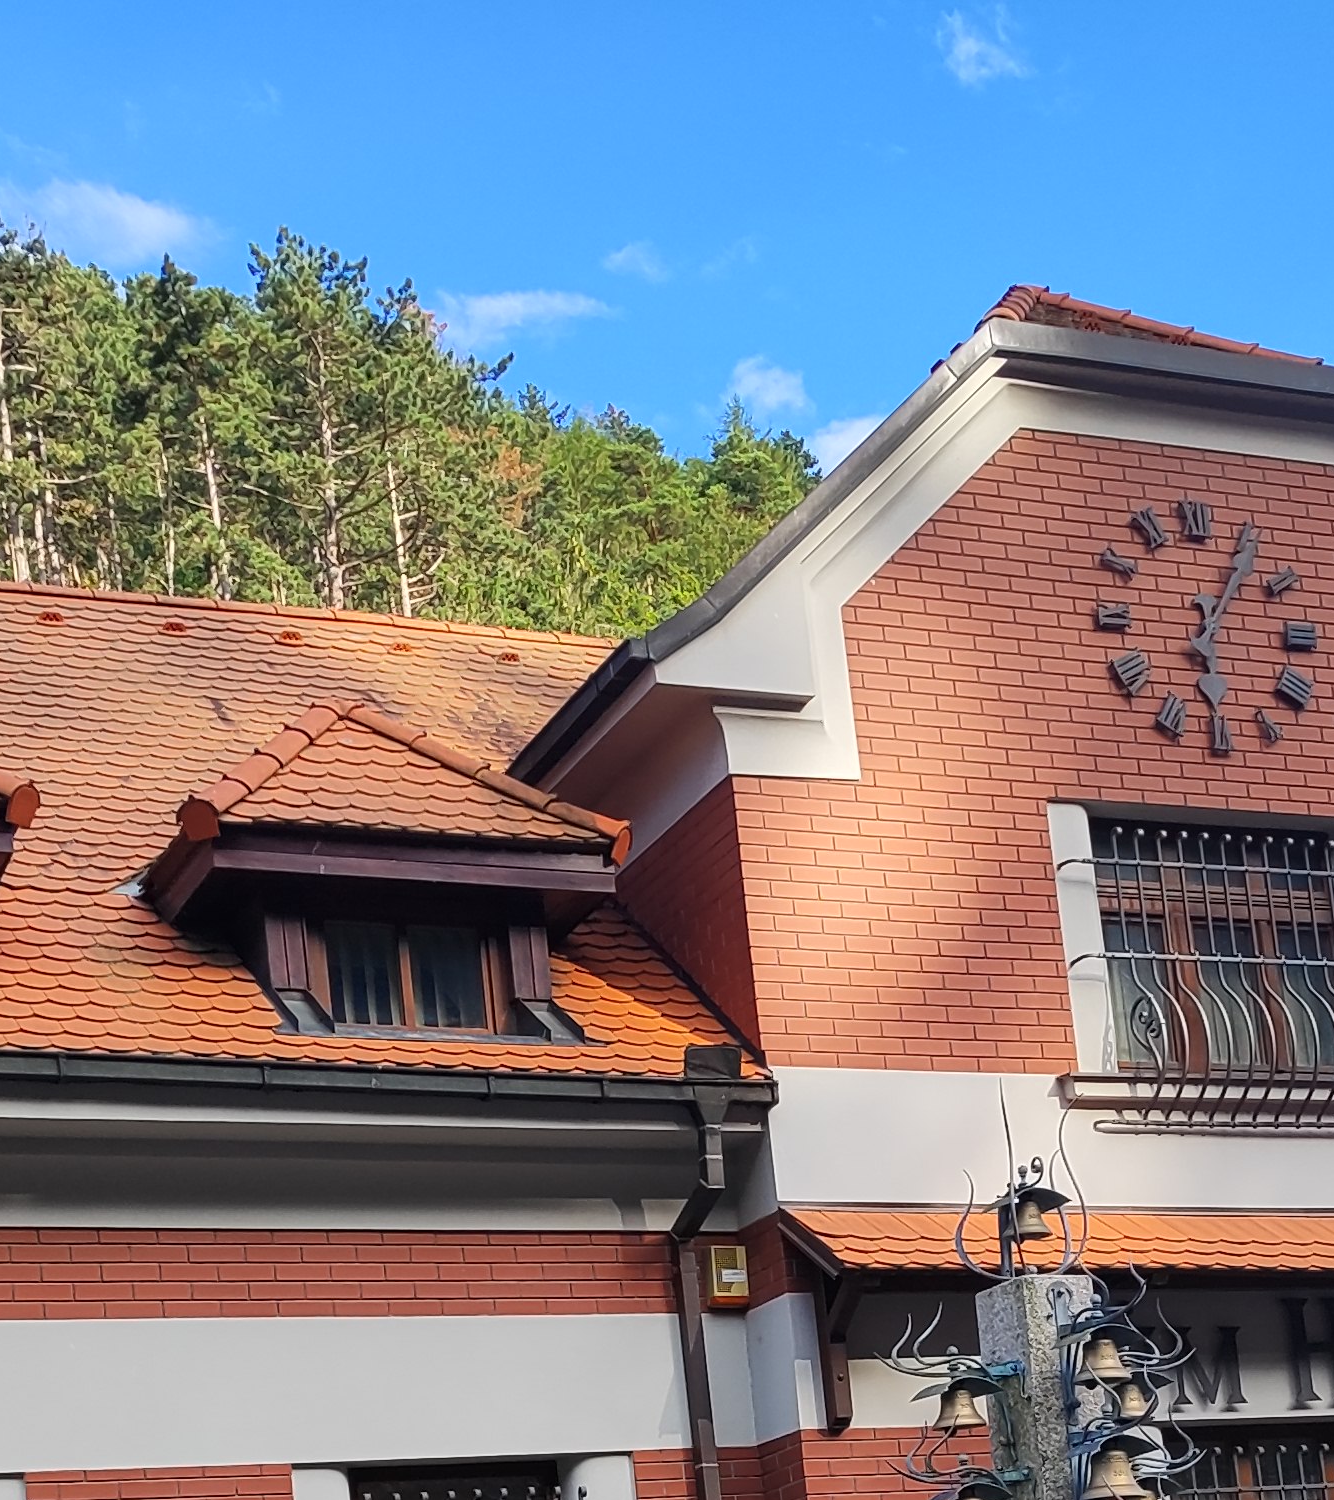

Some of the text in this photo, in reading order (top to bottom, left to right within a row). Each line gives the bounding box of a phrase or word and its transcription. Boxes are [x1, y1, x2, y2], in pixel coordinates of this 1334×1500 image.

[1131, 507, 1169, 549] XI
[1177, 500, 1213, 540] XII
[1100, 543, 1138, 583] X
[1266, 566, 1299, 596] II
[1097, 602, 1133, 629] IX
[1283, 621, 1318, 650] III
[1109, 647, 1152, 697] VIII
[1156, 690, 1187, 738] VII
[1211, 712, 1234, 752] VI
[1255, 707, 1284, 743] V
